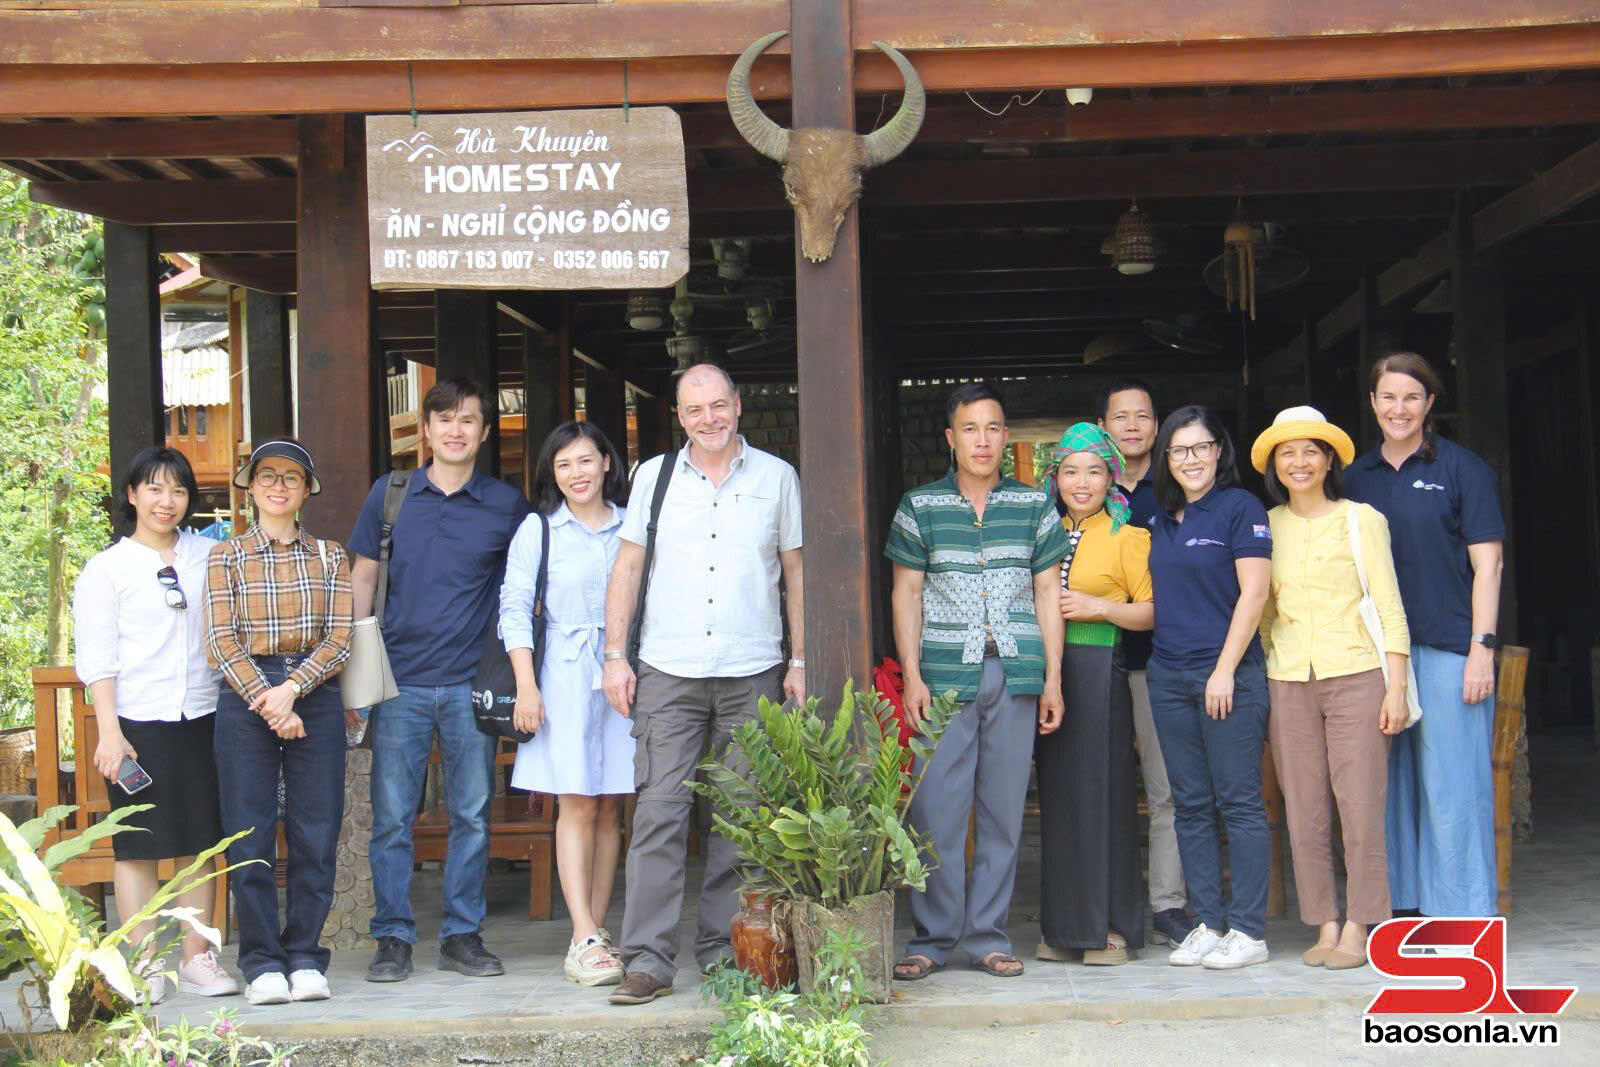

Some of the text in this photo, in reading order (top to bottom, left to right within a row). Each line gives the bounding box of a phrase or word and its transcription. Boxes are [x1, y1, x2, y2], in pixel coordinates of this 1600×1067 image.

[454, 125, 610, 158] Hà Khuyên
[424, 162, 623, 193] HOMESTAY
[387, 207, 421, 238] ĂN
[442, 203, 507, 237] NGHỈ
[513, 204, 587, 243] CỘNG
[592, 199, 671, 233] ĐỒNG
[384, 249, 411, 269] ĐT:
[416, 249, 460, 270] 0867
[465, 250, 497, 270] 163
[553, 250, 597, 270] 0352
[601, 250, 633, 270] 006
[638, 250, 671, 270] 567
